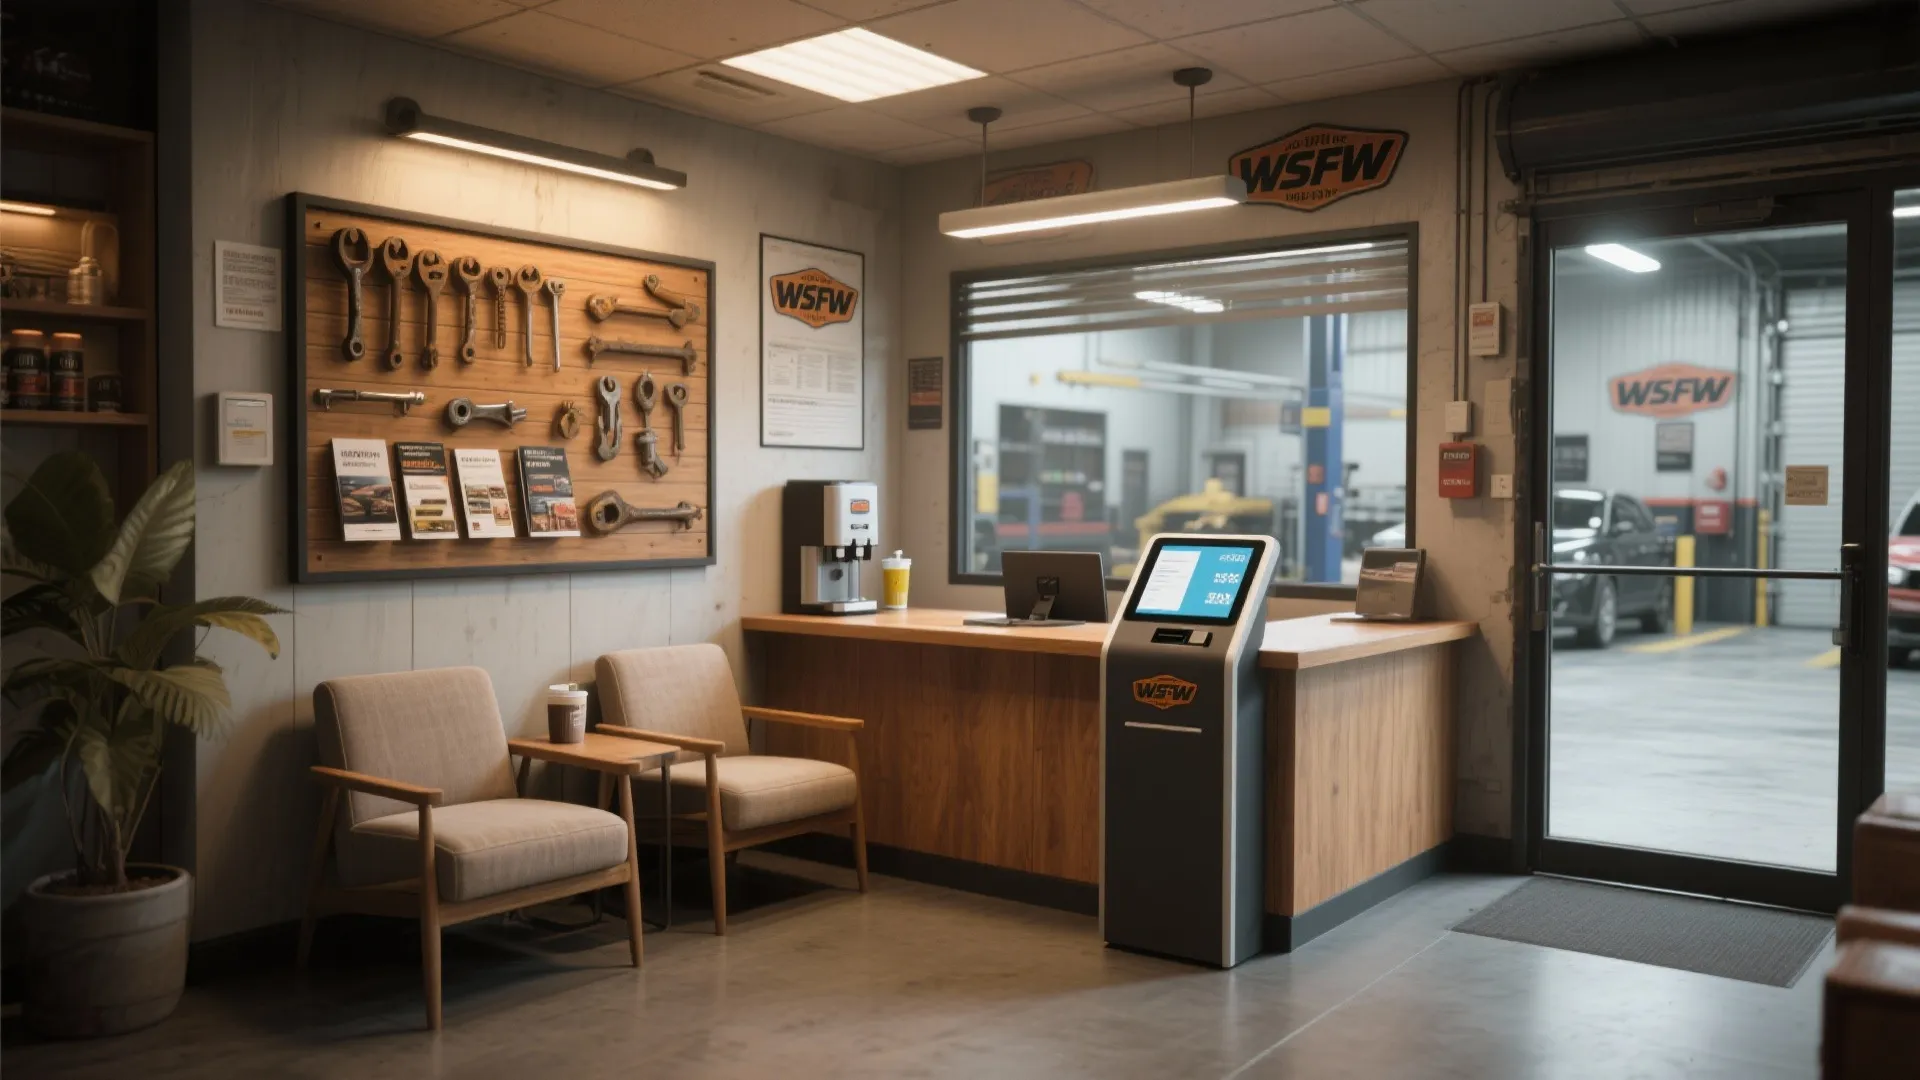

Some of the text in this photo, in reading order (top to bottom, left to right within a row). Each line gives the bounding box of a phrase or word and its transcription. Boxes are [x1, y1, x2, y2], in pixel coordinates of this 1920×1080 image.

[1240, 139, 1395, 194] WSFW
[776, 280, 855, 316] WSFW
[1617, 376, 1731, 406] WSFW
